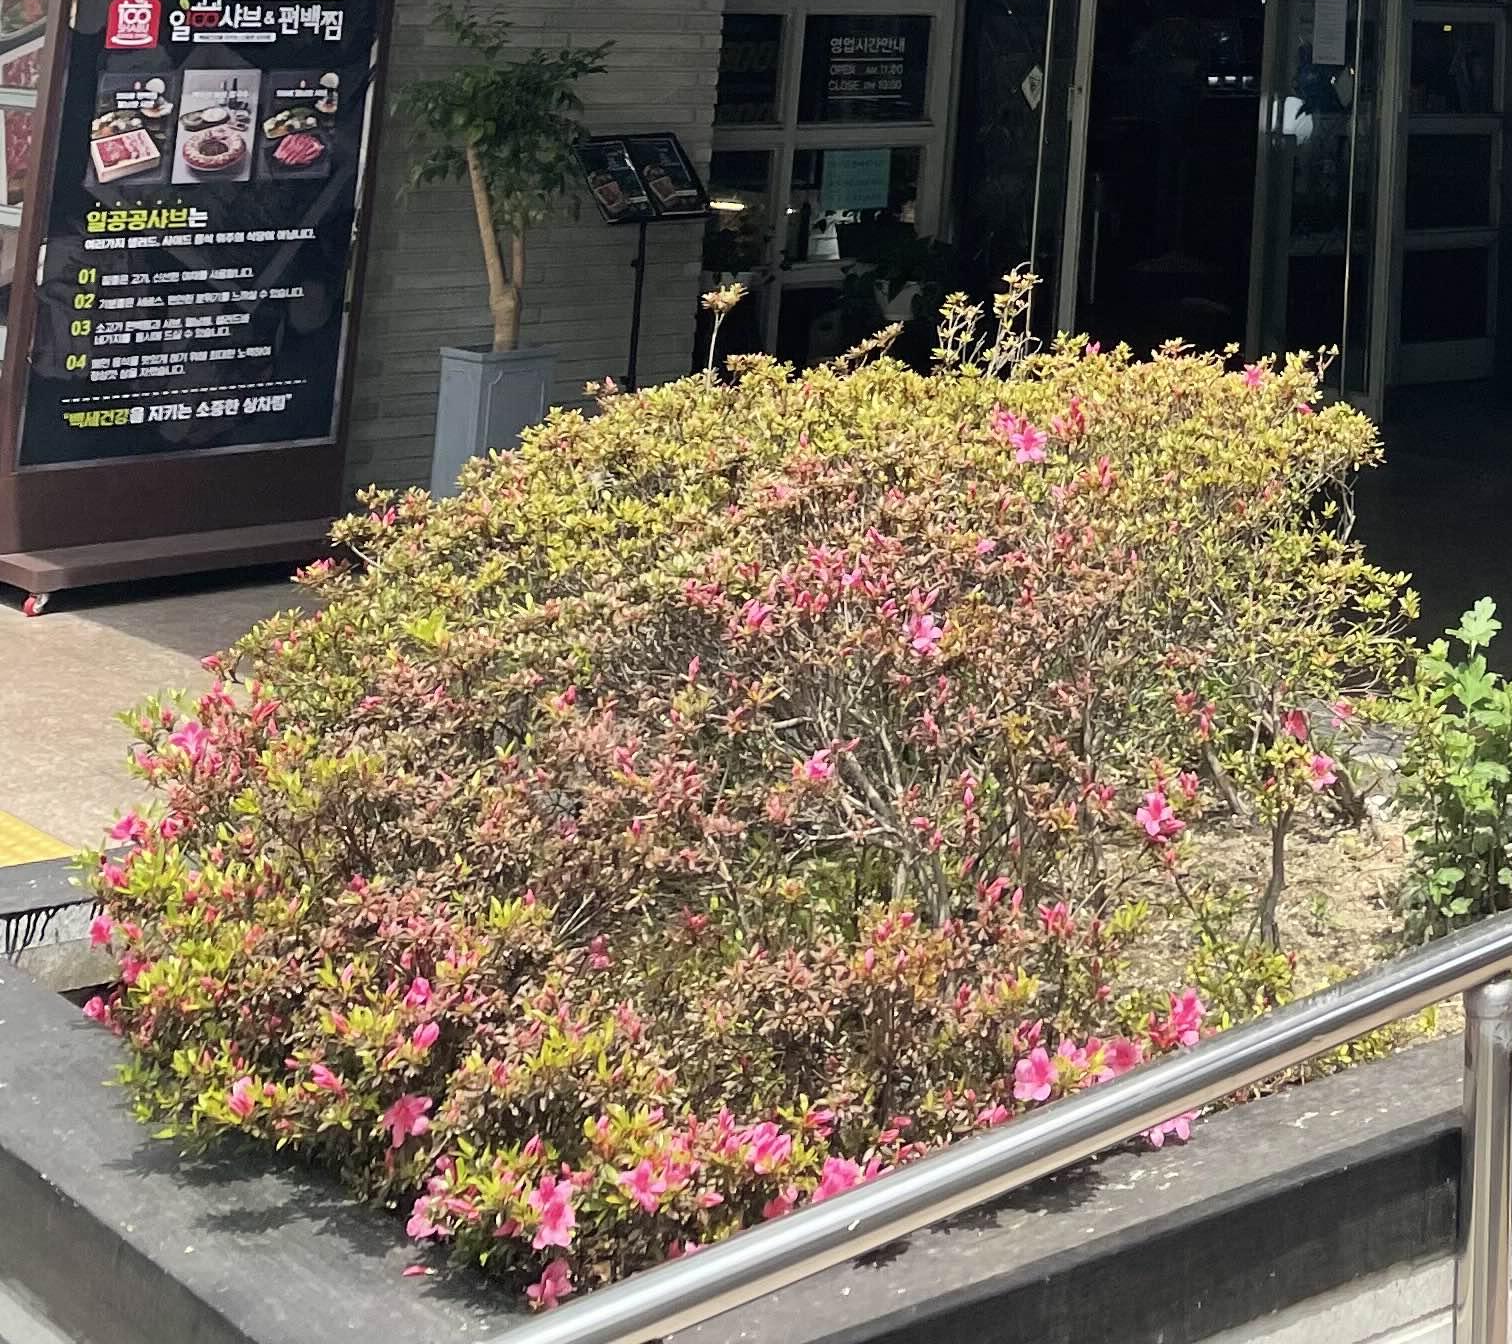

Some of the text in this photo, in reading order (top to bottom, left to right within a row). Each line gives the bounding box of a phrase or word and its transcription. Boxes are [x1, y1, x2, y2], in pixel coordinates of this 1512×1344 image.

[278, 4, 344, 41] 편백찜
[87, 207, 209, 233] 일공공샤브는
[78, 267, 97, 285] 01
[74, 293, 96, 310] 02
[70, 320, 91, 337] 03
[66, 354, 87, 371] 04
[148, 402, 193, 423] 지키는
[195, 398, 240, 419] 소중한
